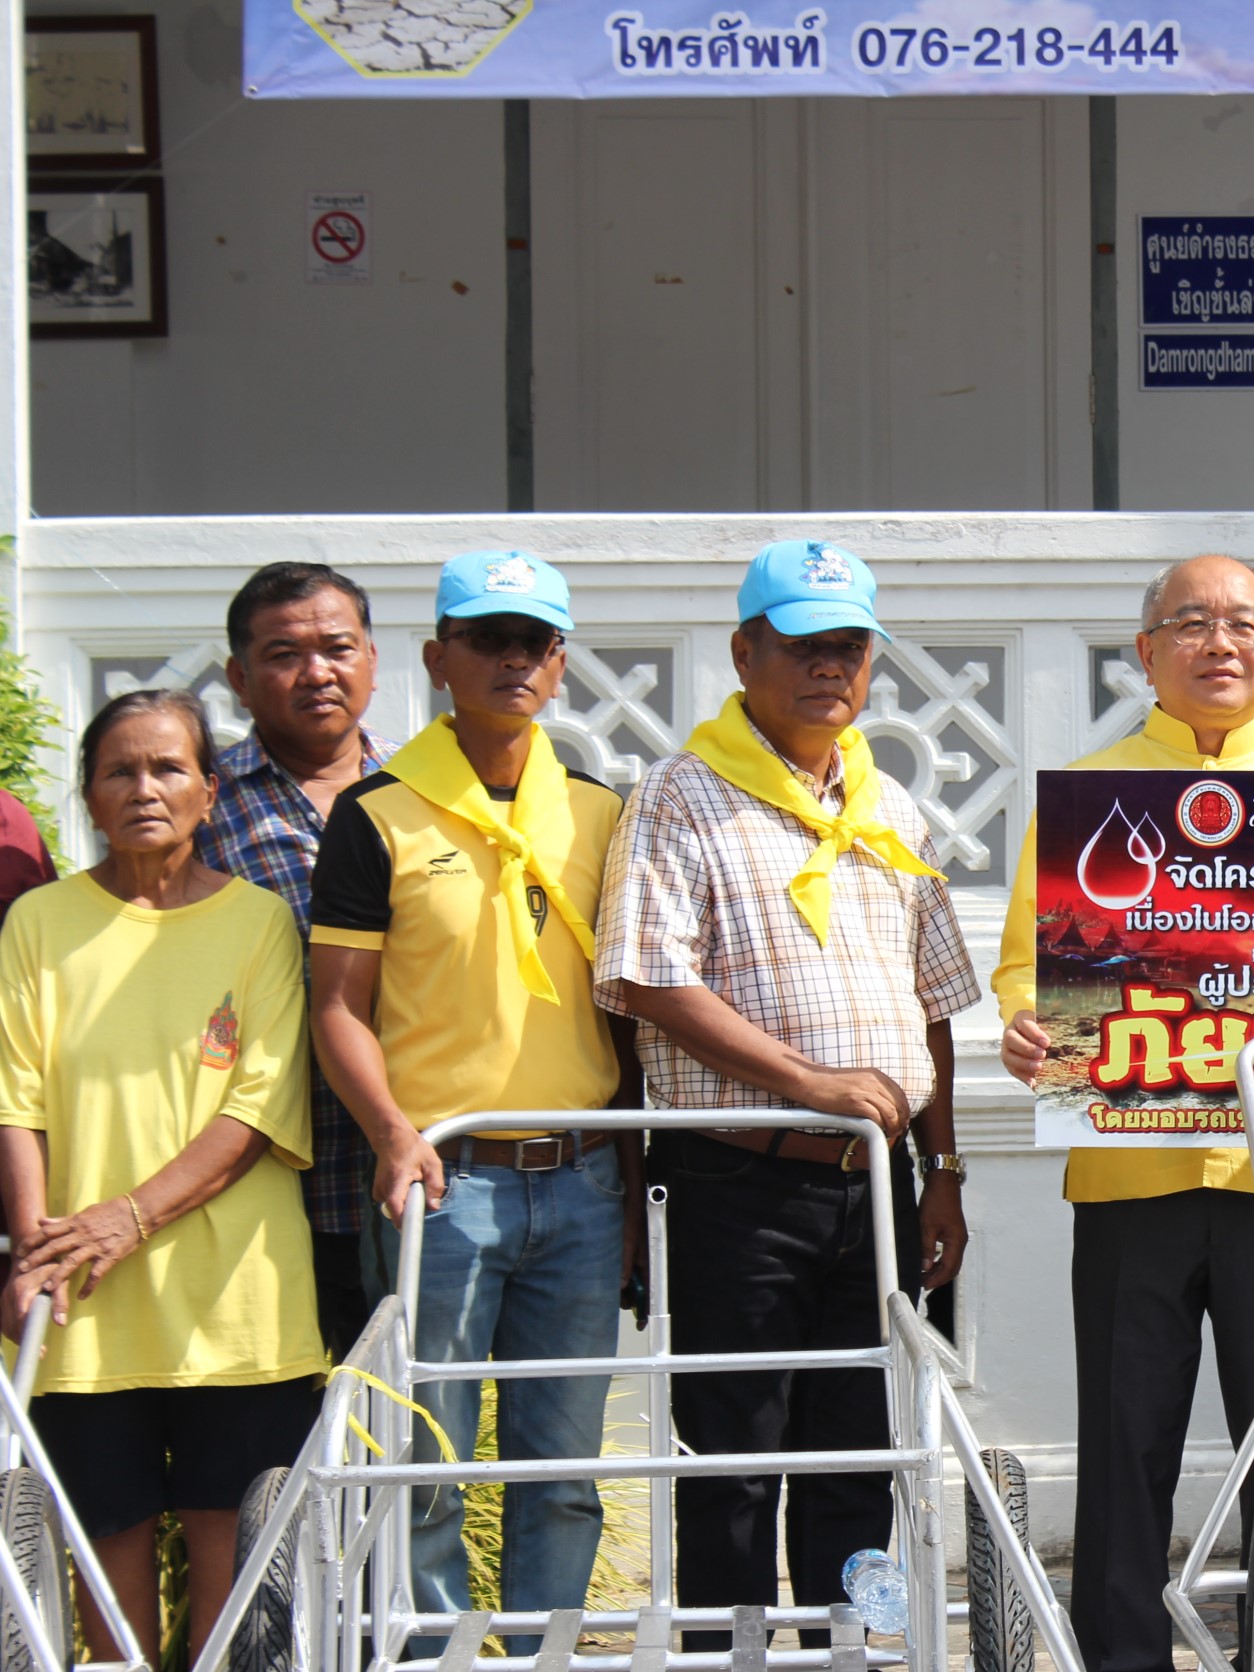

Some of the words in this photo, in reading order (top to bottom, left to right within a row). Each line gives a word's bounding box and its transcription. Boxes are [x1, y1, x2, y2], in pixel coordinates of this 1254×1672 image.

[614, 17, 821, 69] โทรศัพท์
[858, 26, 1179, 68] 076-218-444
